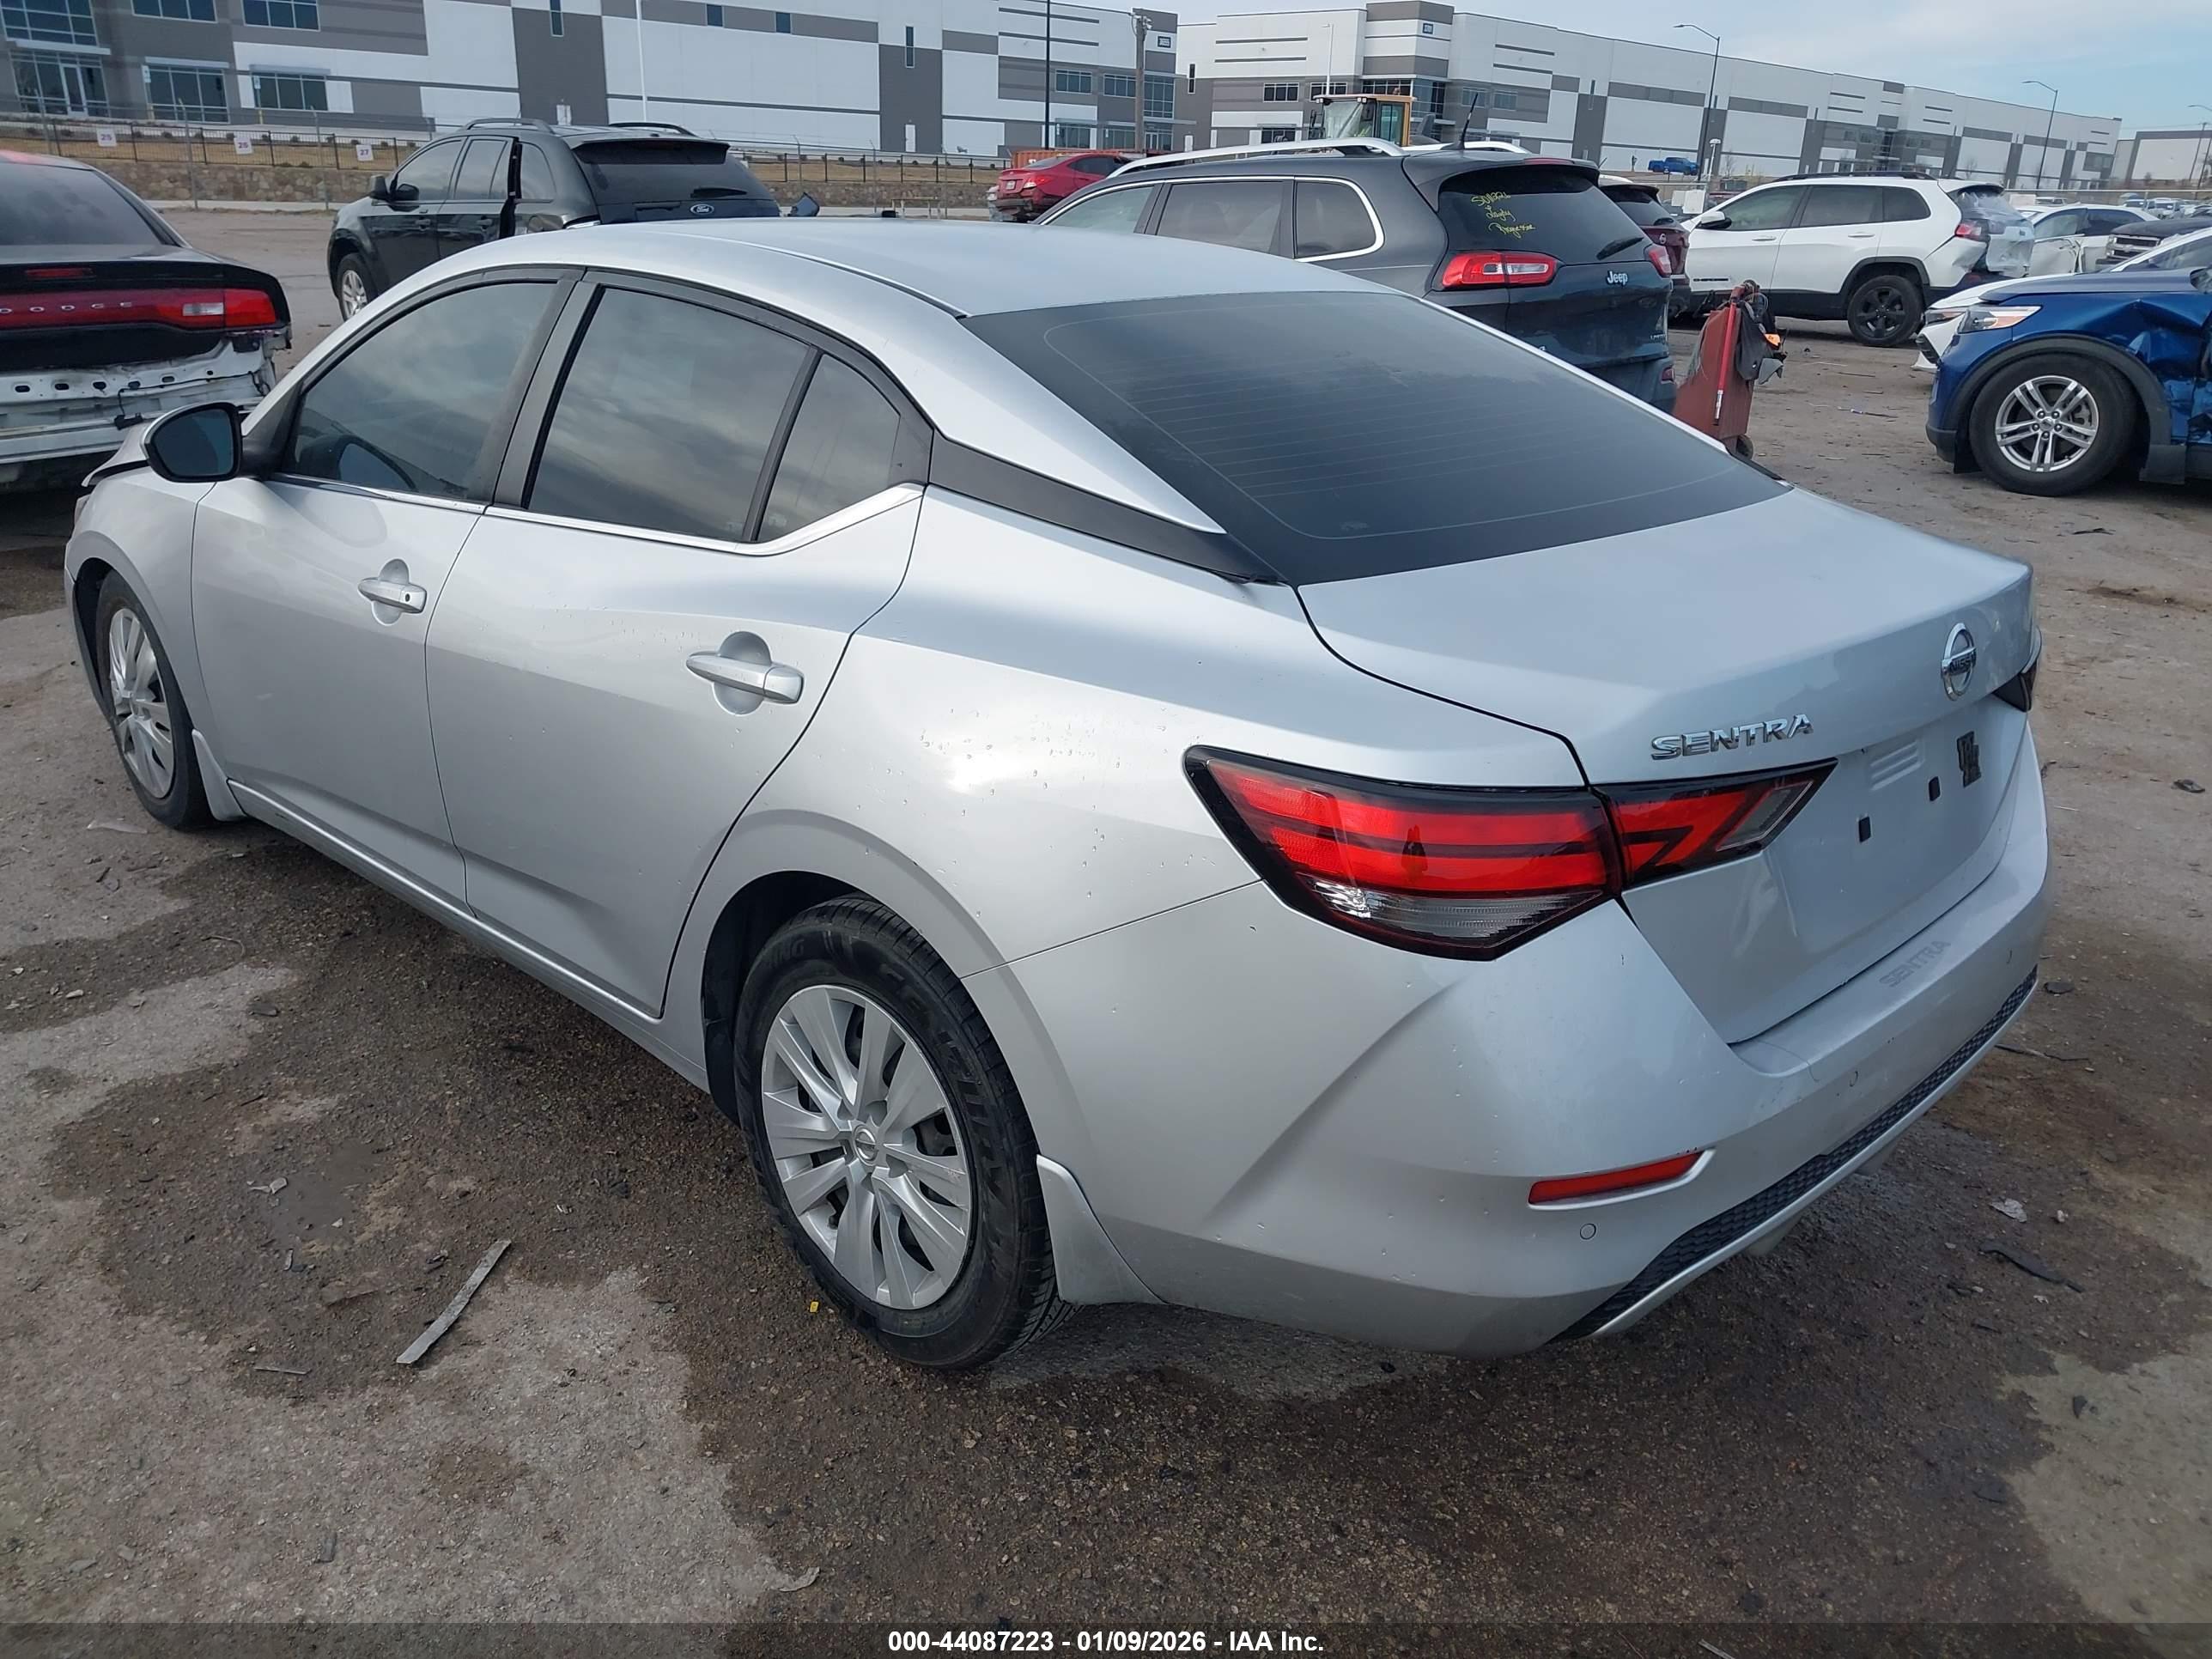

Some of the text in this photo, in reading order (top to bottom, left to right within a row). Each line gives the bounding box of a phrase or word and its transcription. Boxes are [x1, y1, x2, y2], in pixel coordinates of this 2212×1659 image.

[1607, 270, 1628, 286] Jeep
[1650, 714, 1814, 761] SENTRA
[1879, 940, 1952, 988] SENTRA
